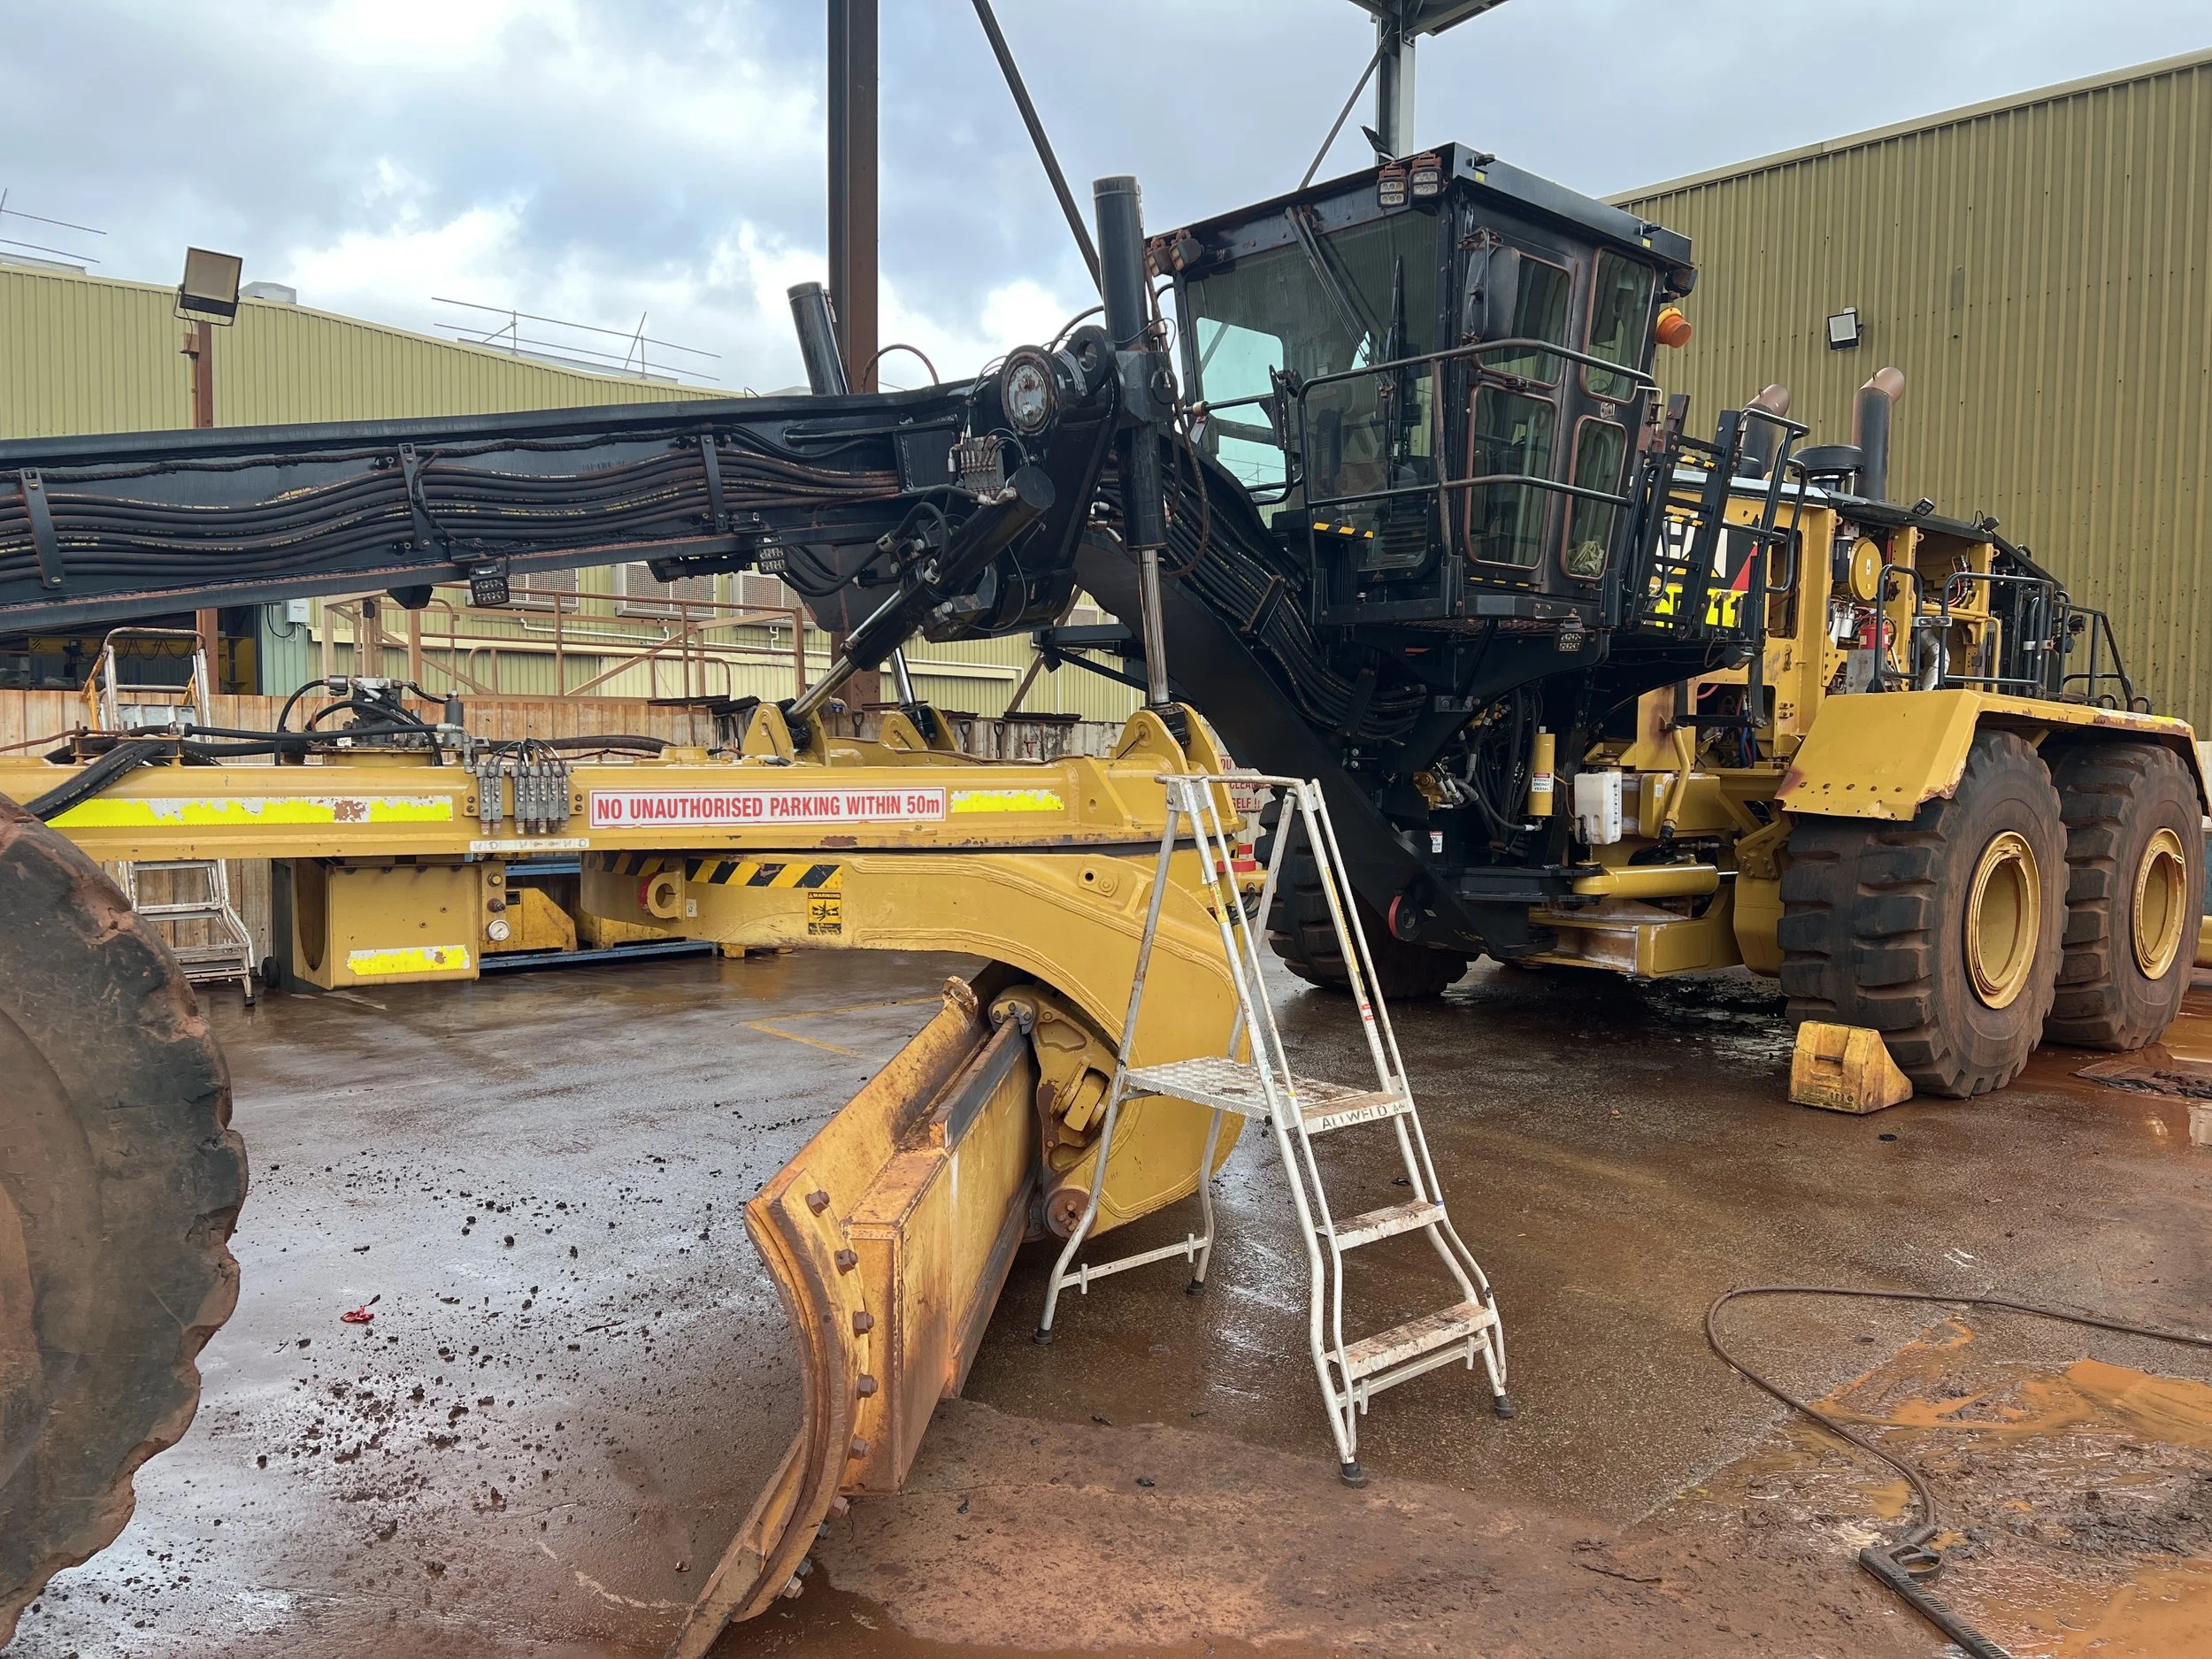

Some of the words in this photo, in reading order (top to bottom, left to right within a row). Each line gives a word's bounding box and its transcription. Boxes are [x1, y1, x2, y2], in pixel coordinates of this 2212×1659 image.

[597, 799, 622, 819] NO
[630, 797, 763, 818] UNAUTHORISED
[770, 795, 841, 817] PARKING
[846, 795, 901, 815] WITHIN
[907, 794, 940, 814] 50m
